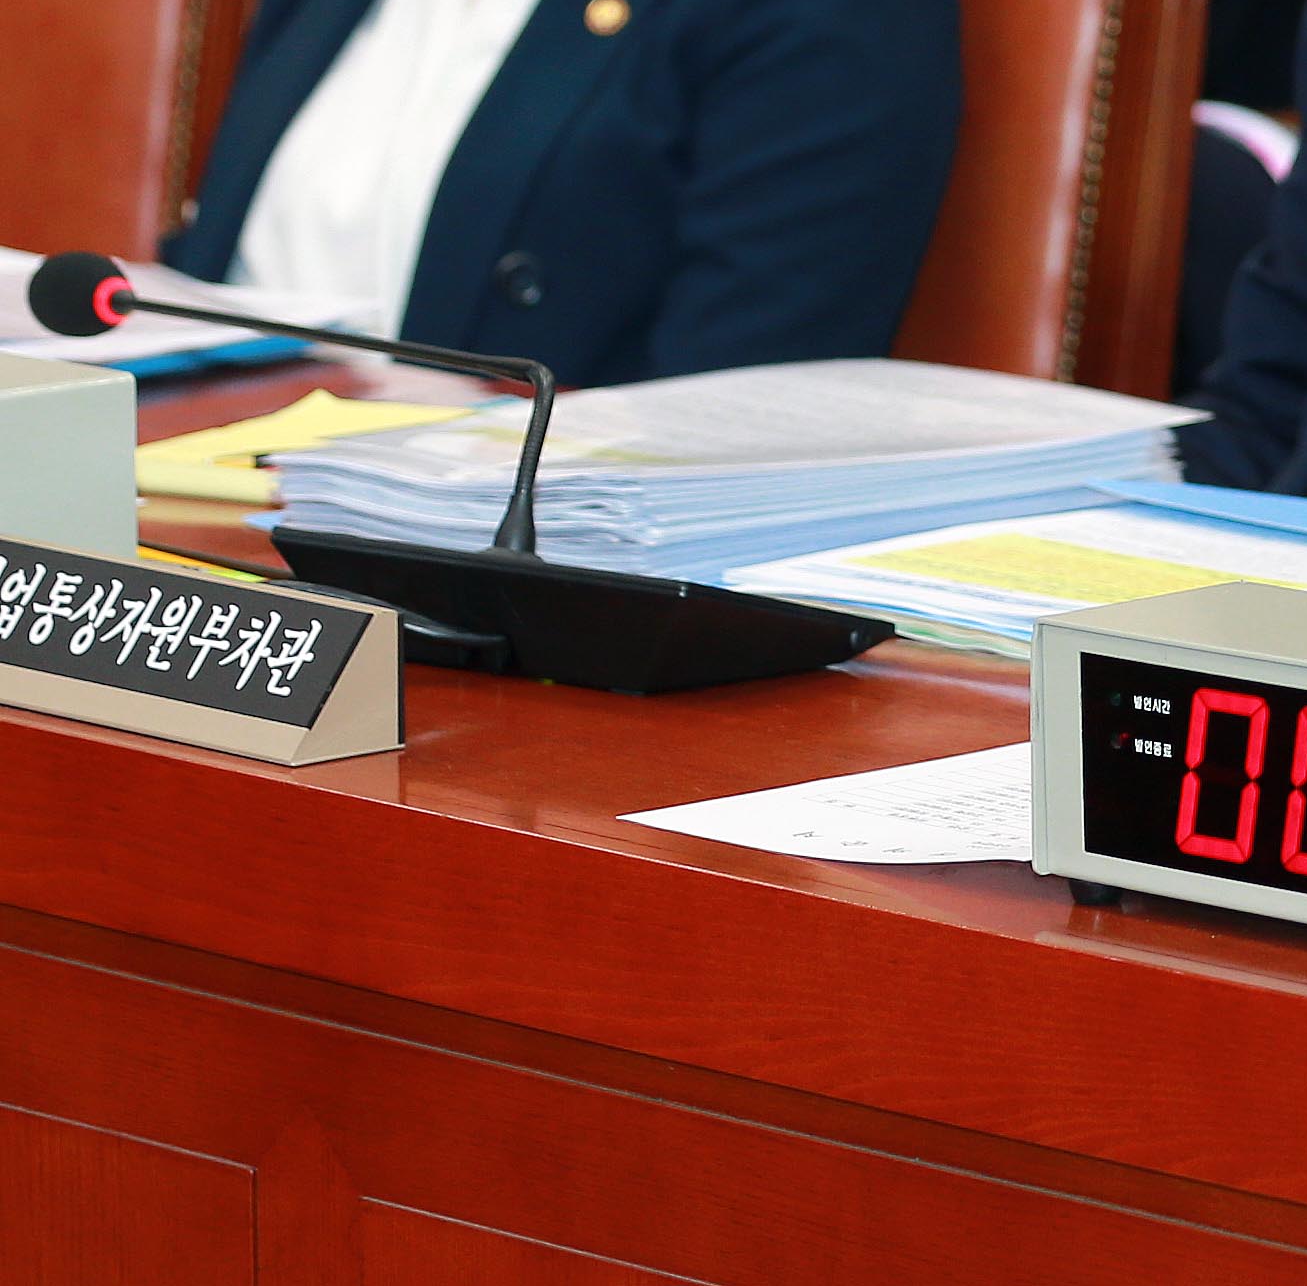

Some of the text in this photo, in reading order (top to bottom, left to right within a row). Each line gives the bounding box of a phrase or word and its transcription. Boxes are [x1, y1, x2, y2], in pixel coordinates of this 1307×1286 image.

[0, 555, 323, 697] 업통상자원부차관
[1133, 695, 1171, 715] 발언시간
[1134, 738, 1173, 758] 발언종료
